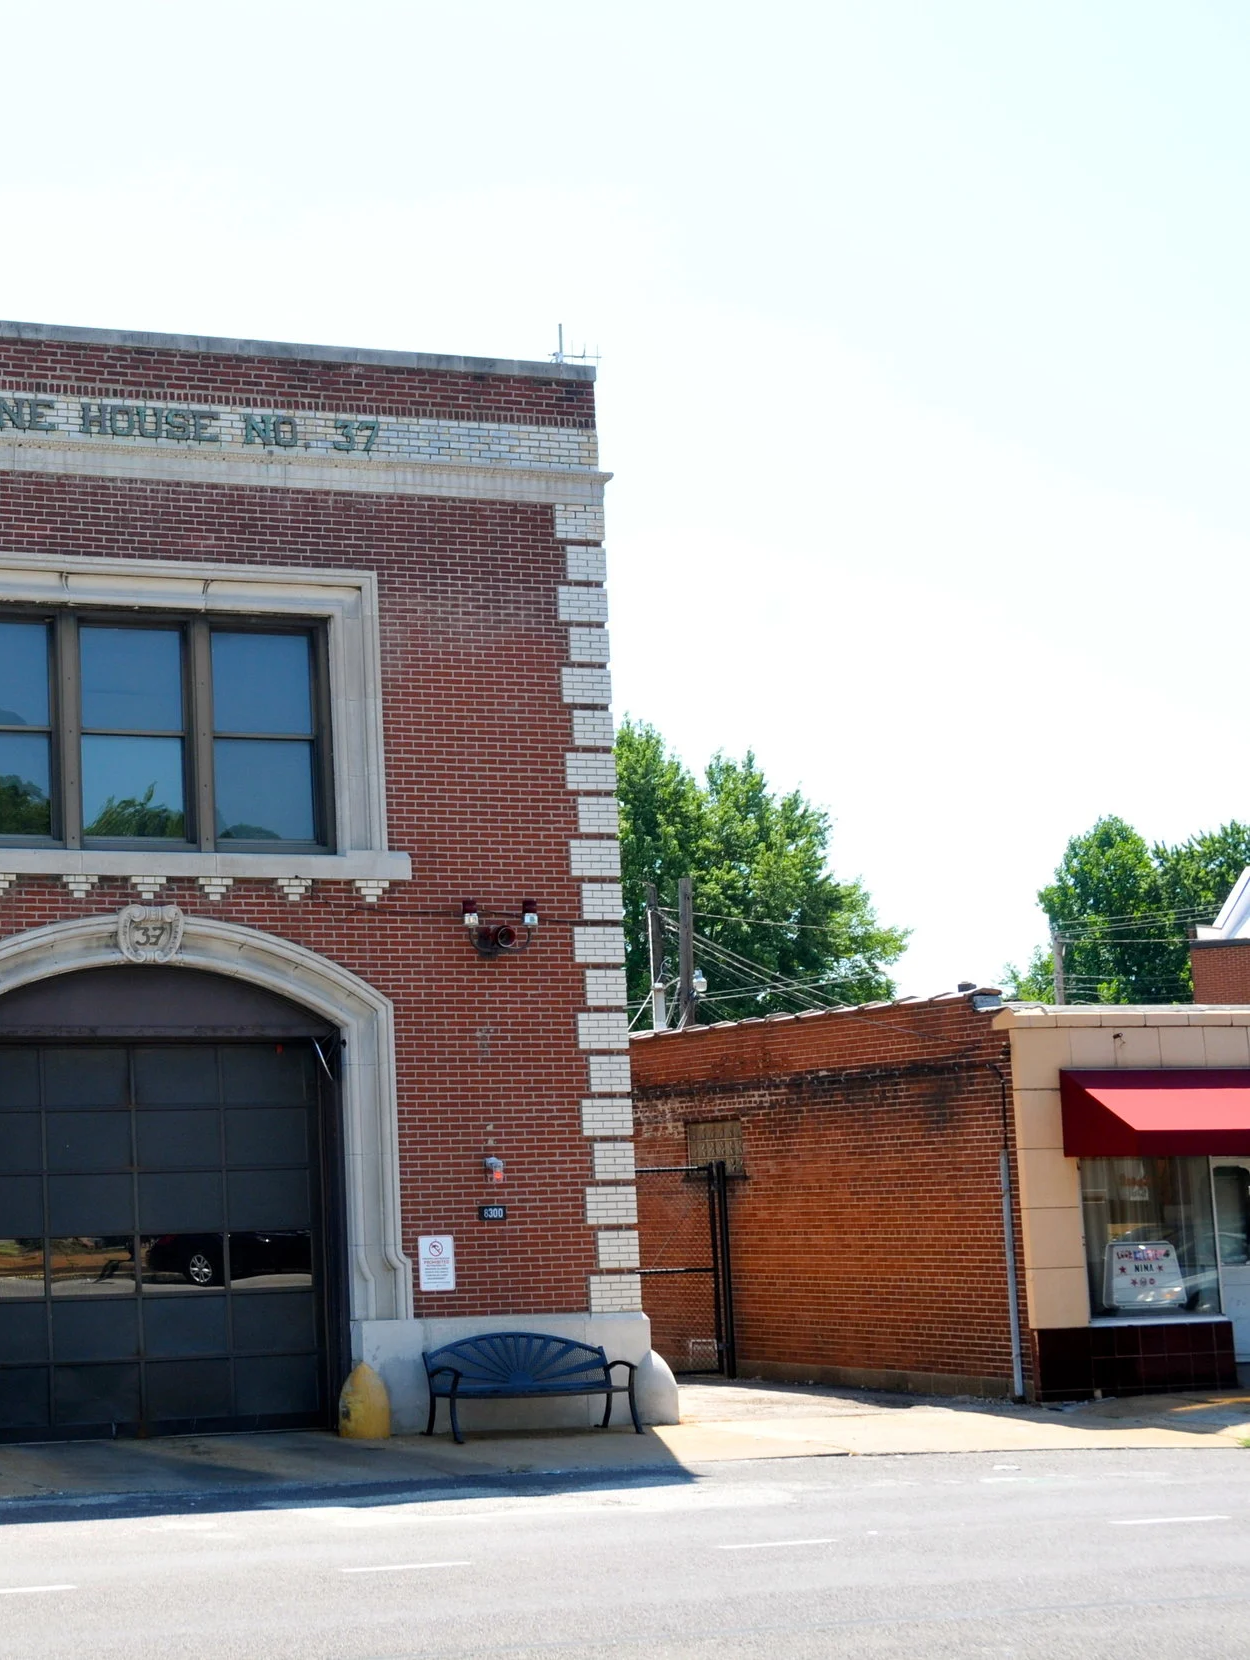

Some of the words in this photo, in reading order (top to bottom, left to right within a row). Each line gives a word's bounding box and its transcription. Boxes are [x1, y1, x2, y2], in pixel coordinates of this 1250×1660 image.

[81, 402, 220, 442] HOUSE
[333, 419, 380, 451] 37
[133, 926, 166, 946] 37
[484, 1208, 503, 1218] 8300
[1134, 1264, 1155, 1273] NINA
